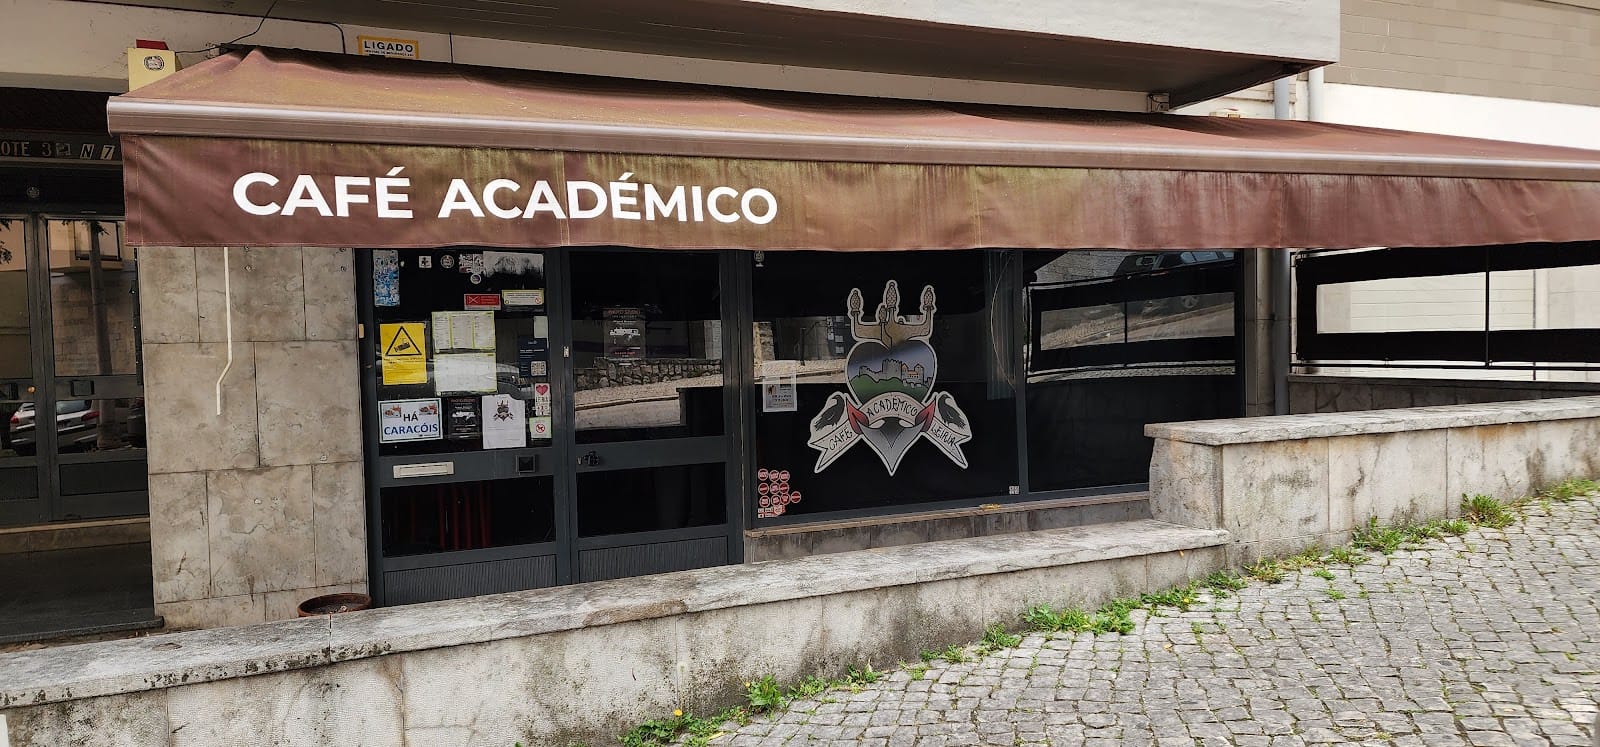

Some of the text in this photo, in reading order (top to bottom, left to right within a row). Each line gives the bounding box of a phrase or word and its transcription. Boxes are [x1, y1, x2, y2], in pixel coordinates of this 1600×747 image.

[364, 41, 413, 53] LIGADO
[0, 141, 31, 156] OTE
[233, 166, 778, 225] CAFÉ ACADÉMICO
[403, 411, 420, 422] HÁ
[384, 423, 438, 435] CARACÓIS
[929, 423, 956, 447] LEIRIA
